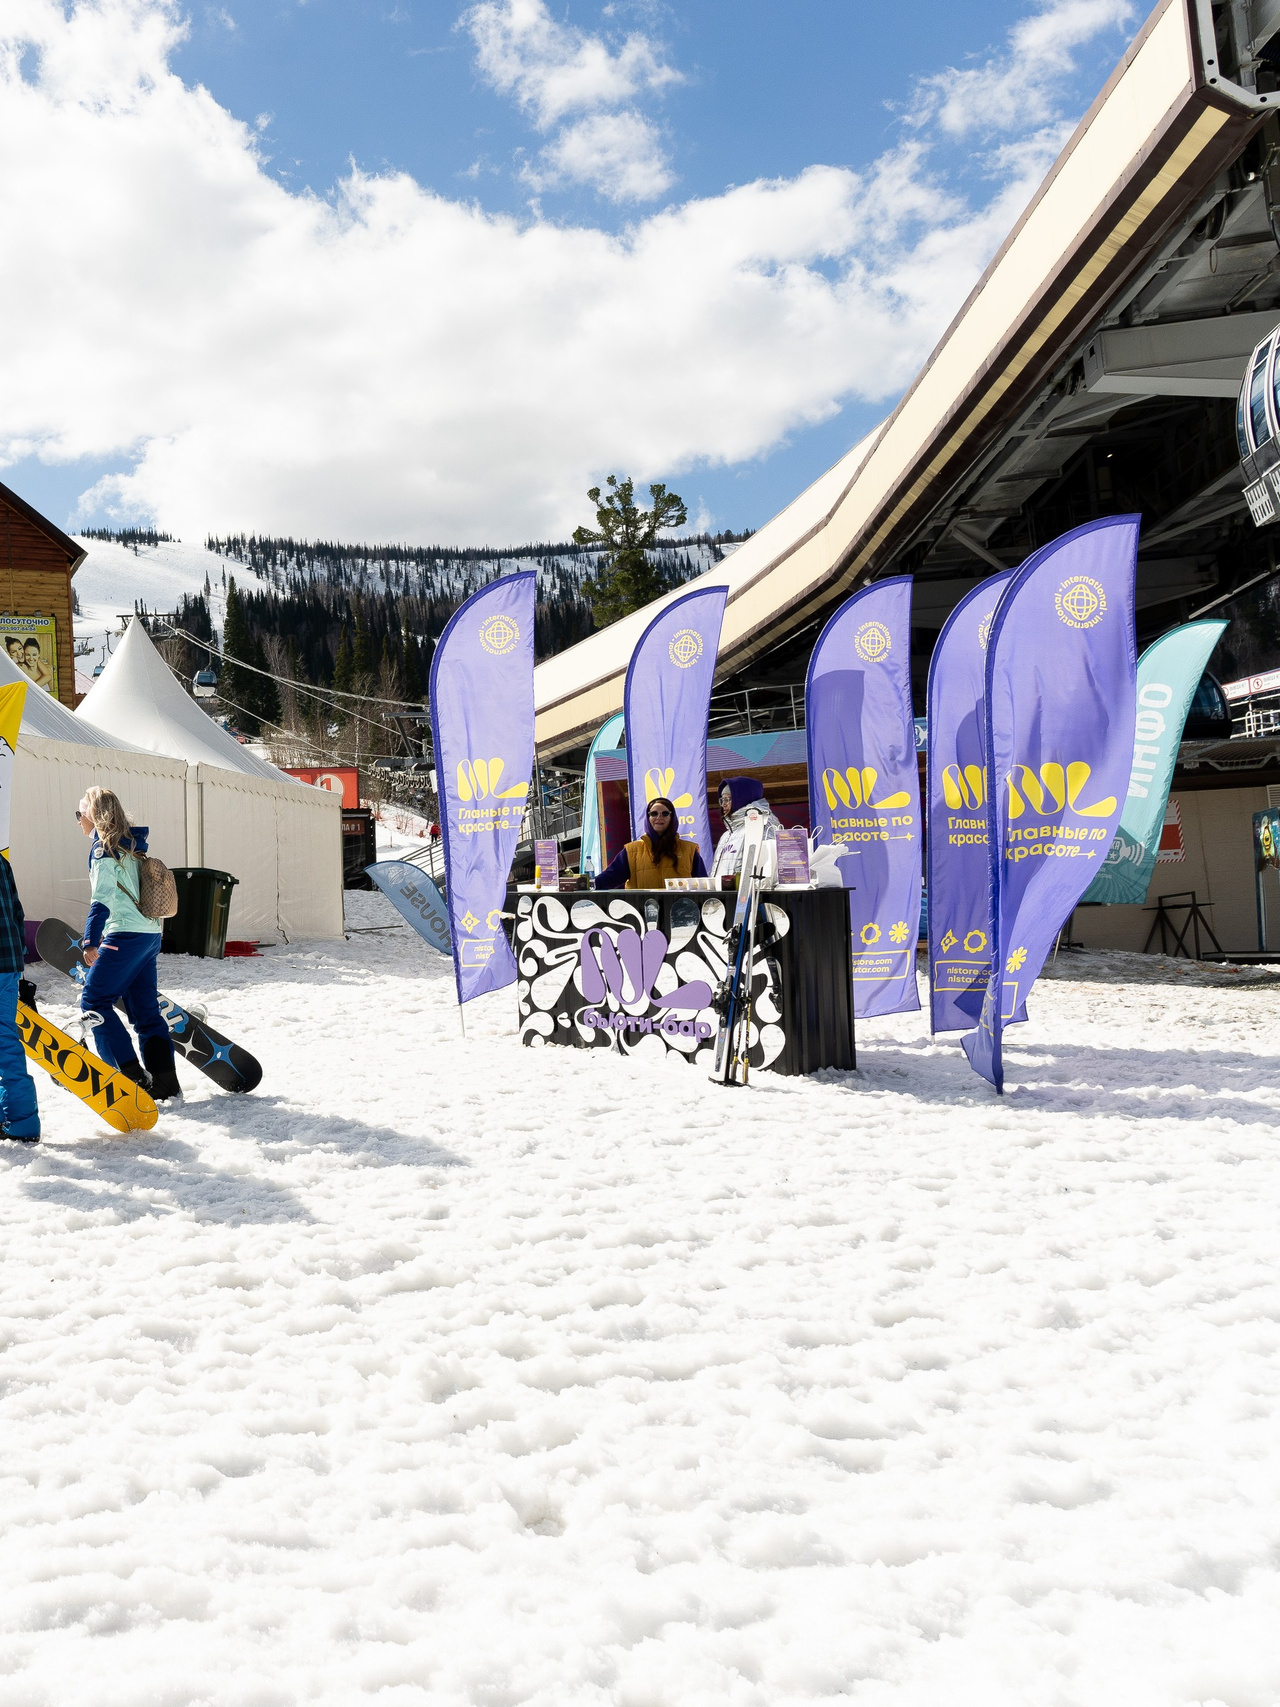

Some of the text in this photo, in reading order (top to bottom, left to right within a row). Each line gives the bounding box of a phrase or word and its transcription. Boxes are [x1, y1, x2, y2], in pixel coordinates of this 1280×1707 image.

[892, 815, 914, 826] по
[1088, 828, 1108, 840] по
[1005, 843, 1080, 862] красоте
[583, 1008, 712, 1044] бьюти-бар
